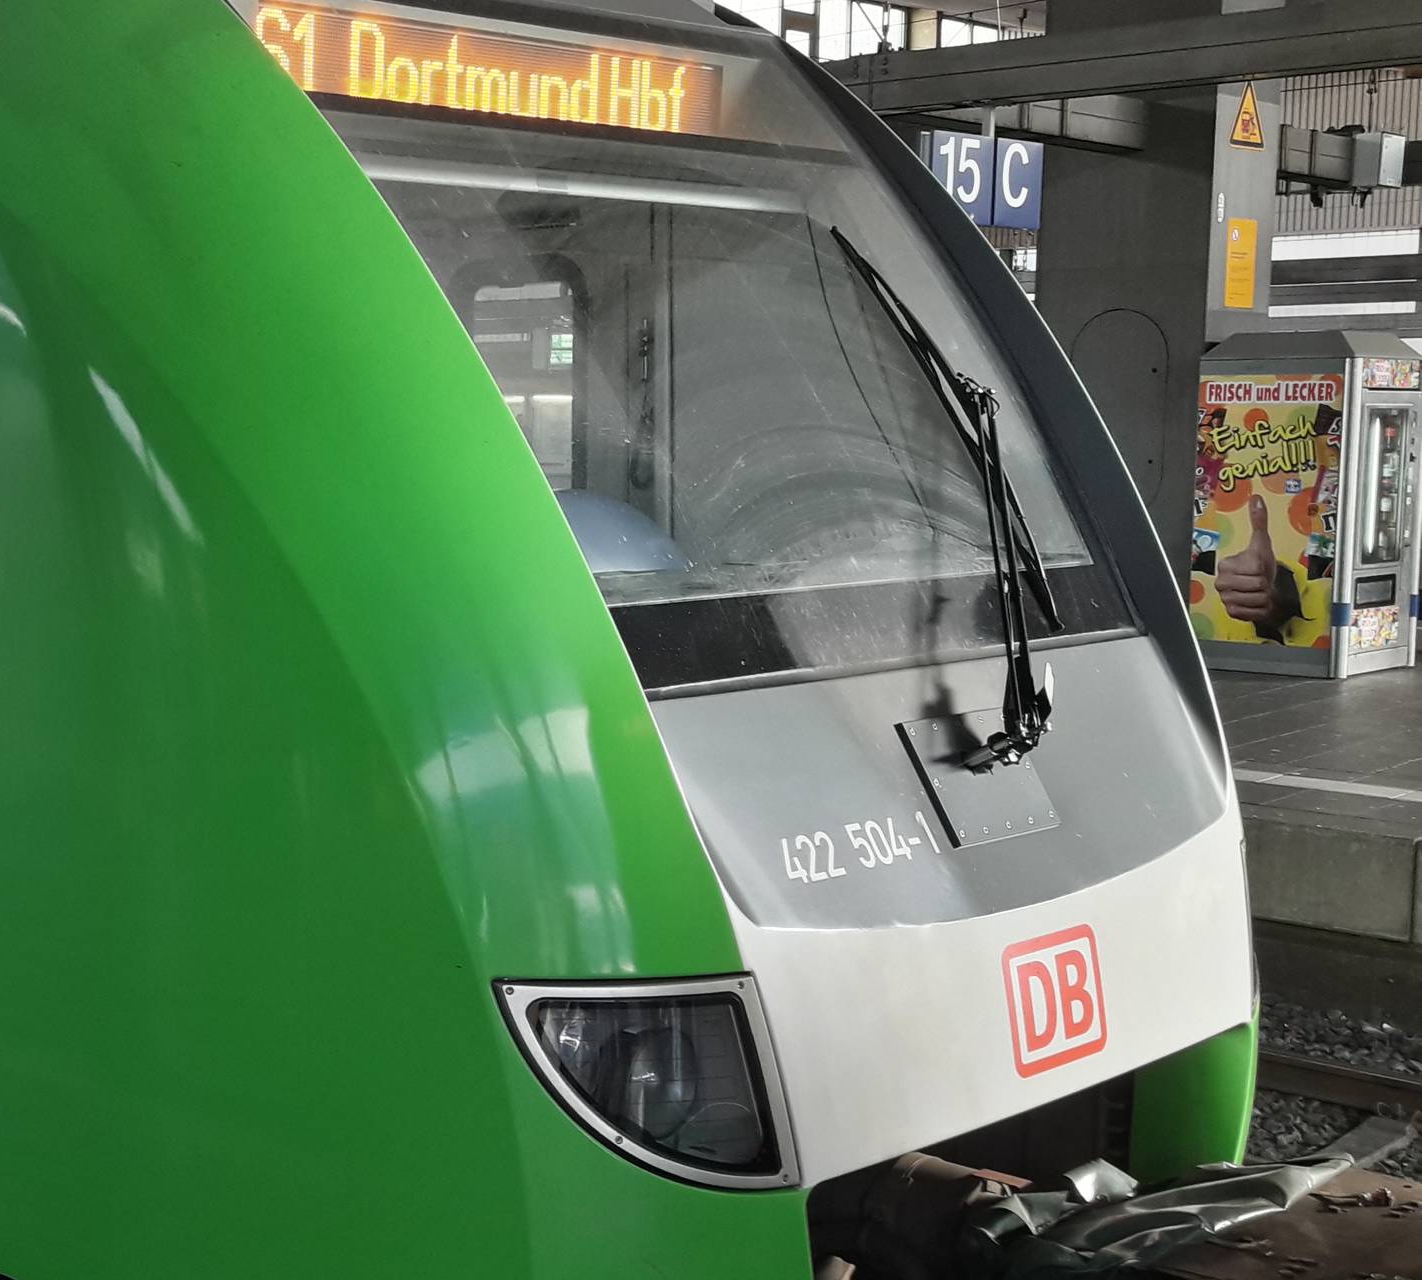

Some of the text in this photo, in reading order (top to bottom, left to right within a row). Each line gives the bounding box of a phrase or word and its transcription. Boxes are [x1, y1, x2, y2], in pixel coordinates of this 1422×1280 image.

[255, 6, 685, 133] S1 Dortmund Hbf
[939, 135, 1029, 208] 15 C
[1207, 381, 1335, 403] FRISCH und LECKER
[1210, 415, 1316, 454] Einfach
[1217, 439, 1317, 492] genial!!!
[780, 810, 940, 884] 422 504-1
[1016, 949, 1094, 1053] DB
